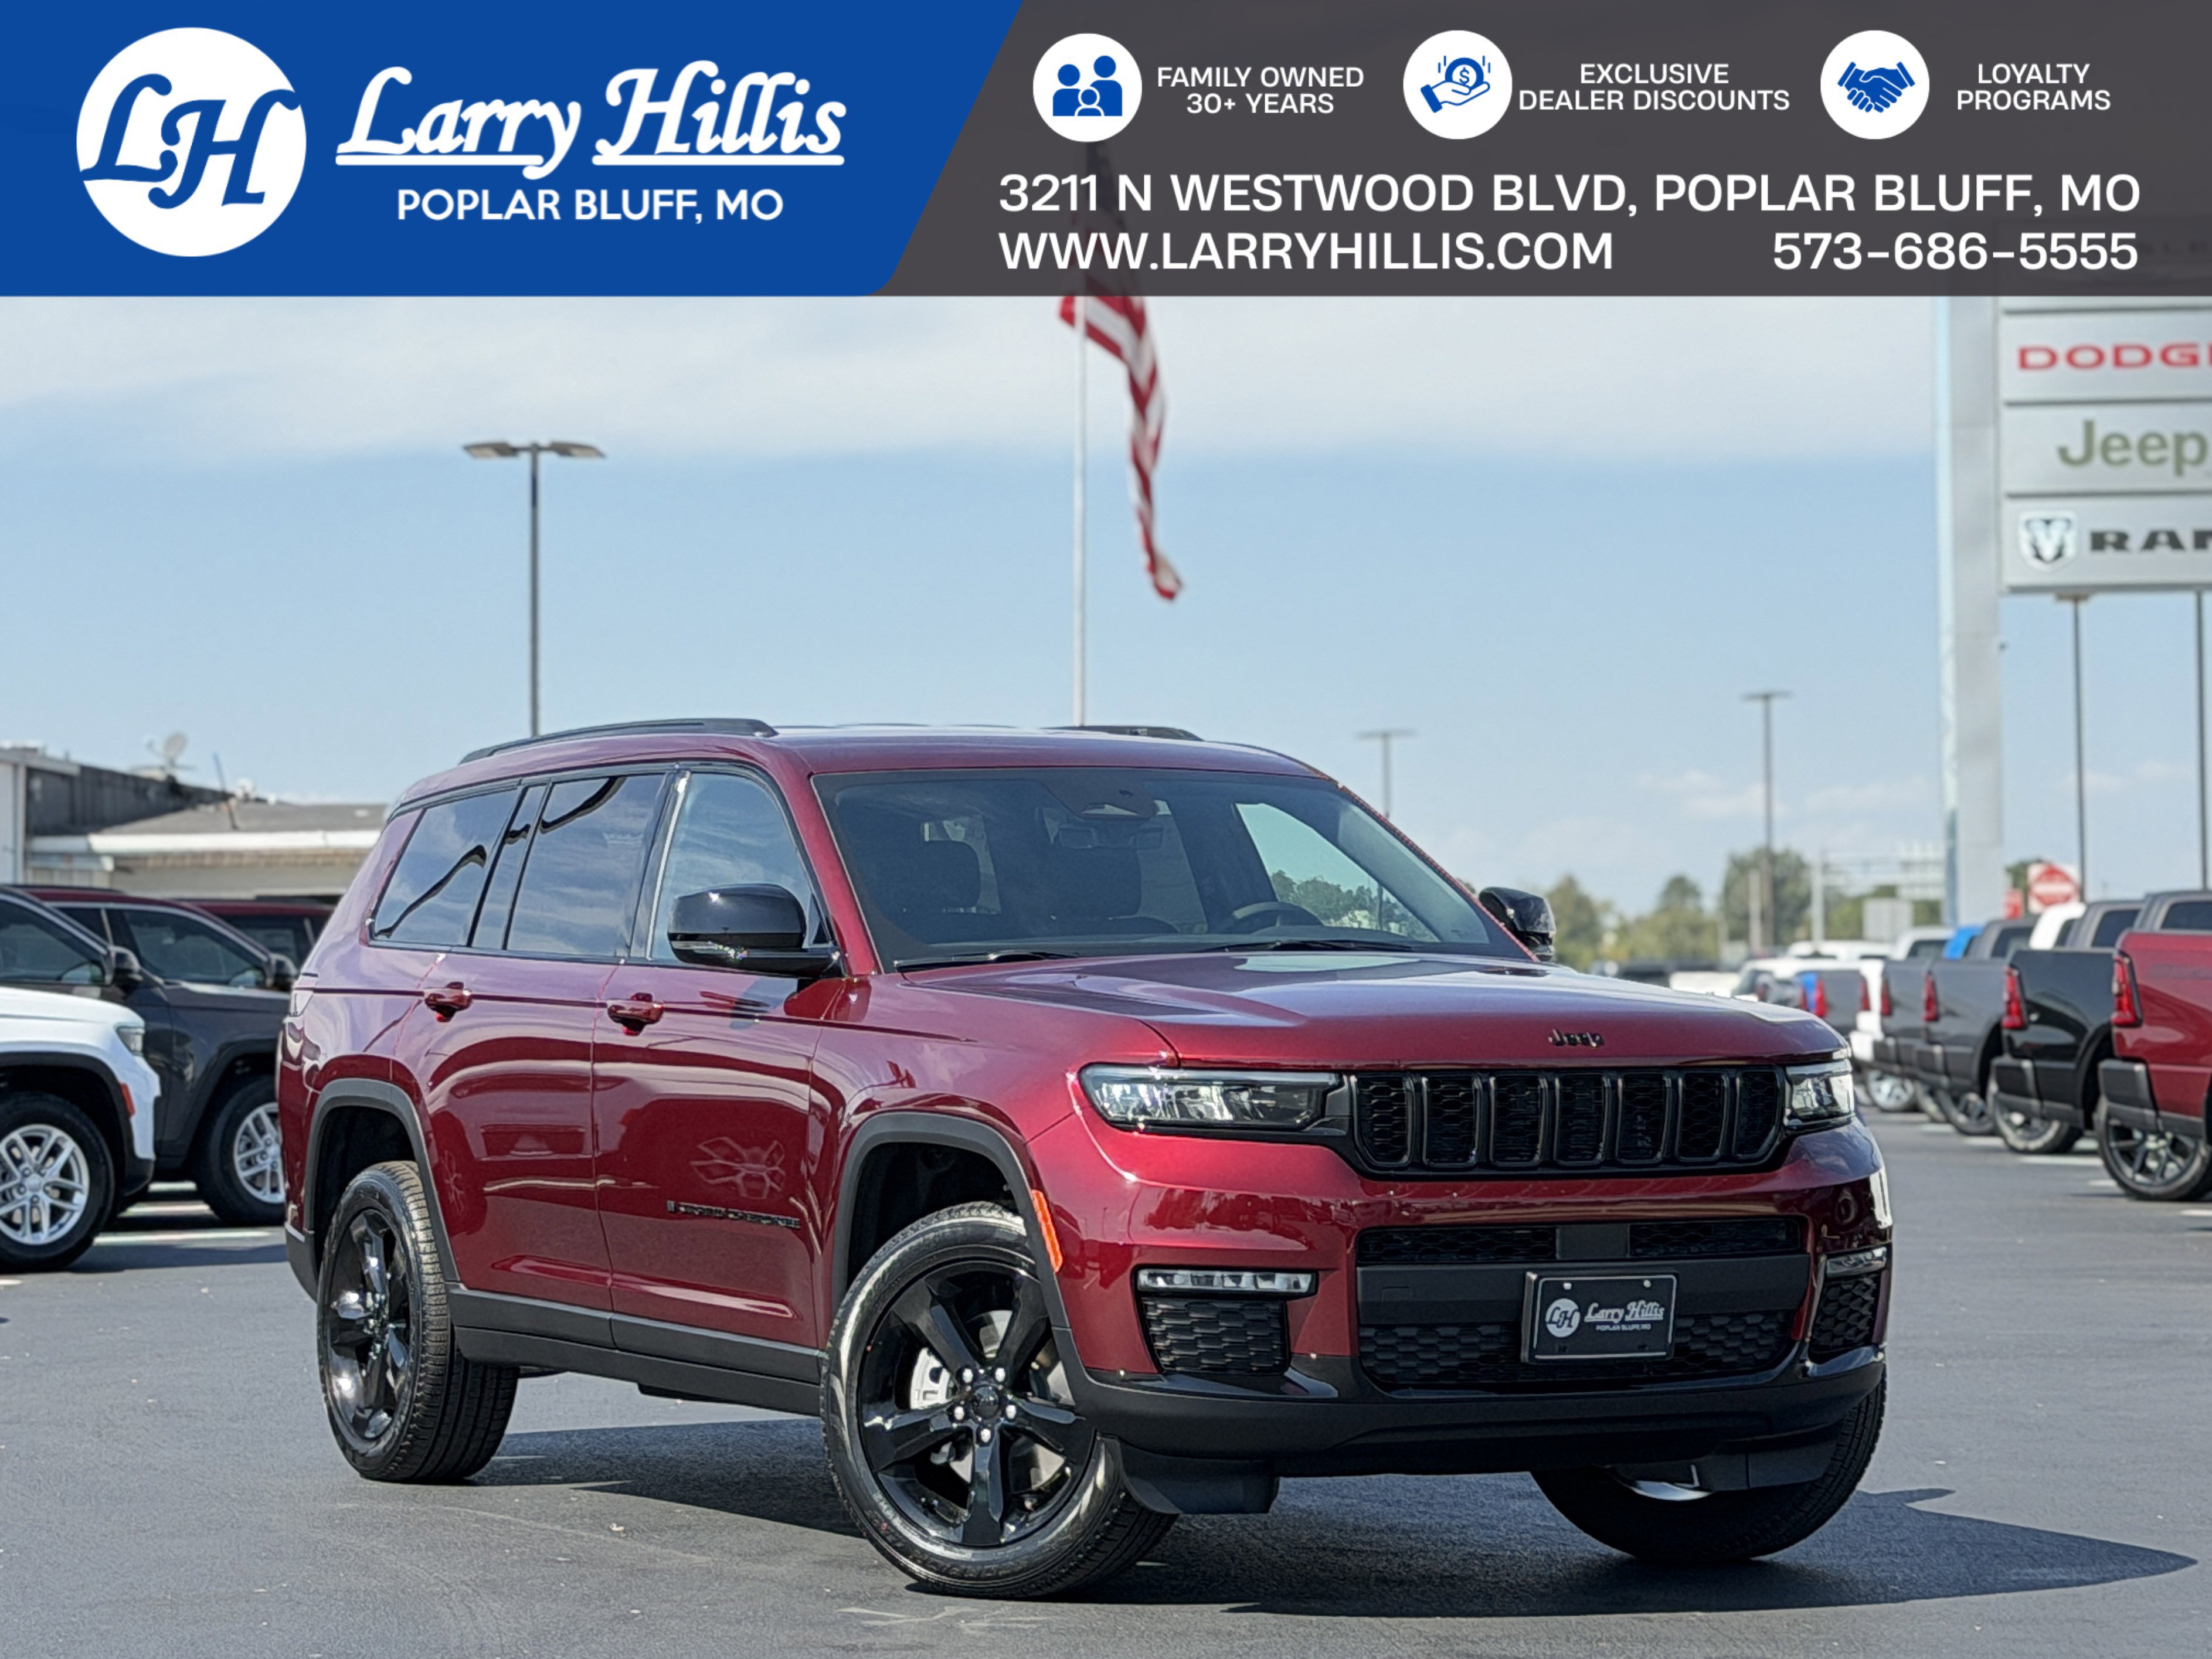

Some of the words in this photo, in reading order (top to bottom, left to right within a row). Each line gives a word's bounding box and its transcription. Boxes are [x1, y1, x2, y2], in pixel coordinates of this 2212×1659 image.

[2019, 343, 2212, 370] DODG
[2058, 420, 2207, 477] Jeep
[1584, 1302, 1624, 1323] Larry
[1625, 1300, 1665, 1321] Hillis
